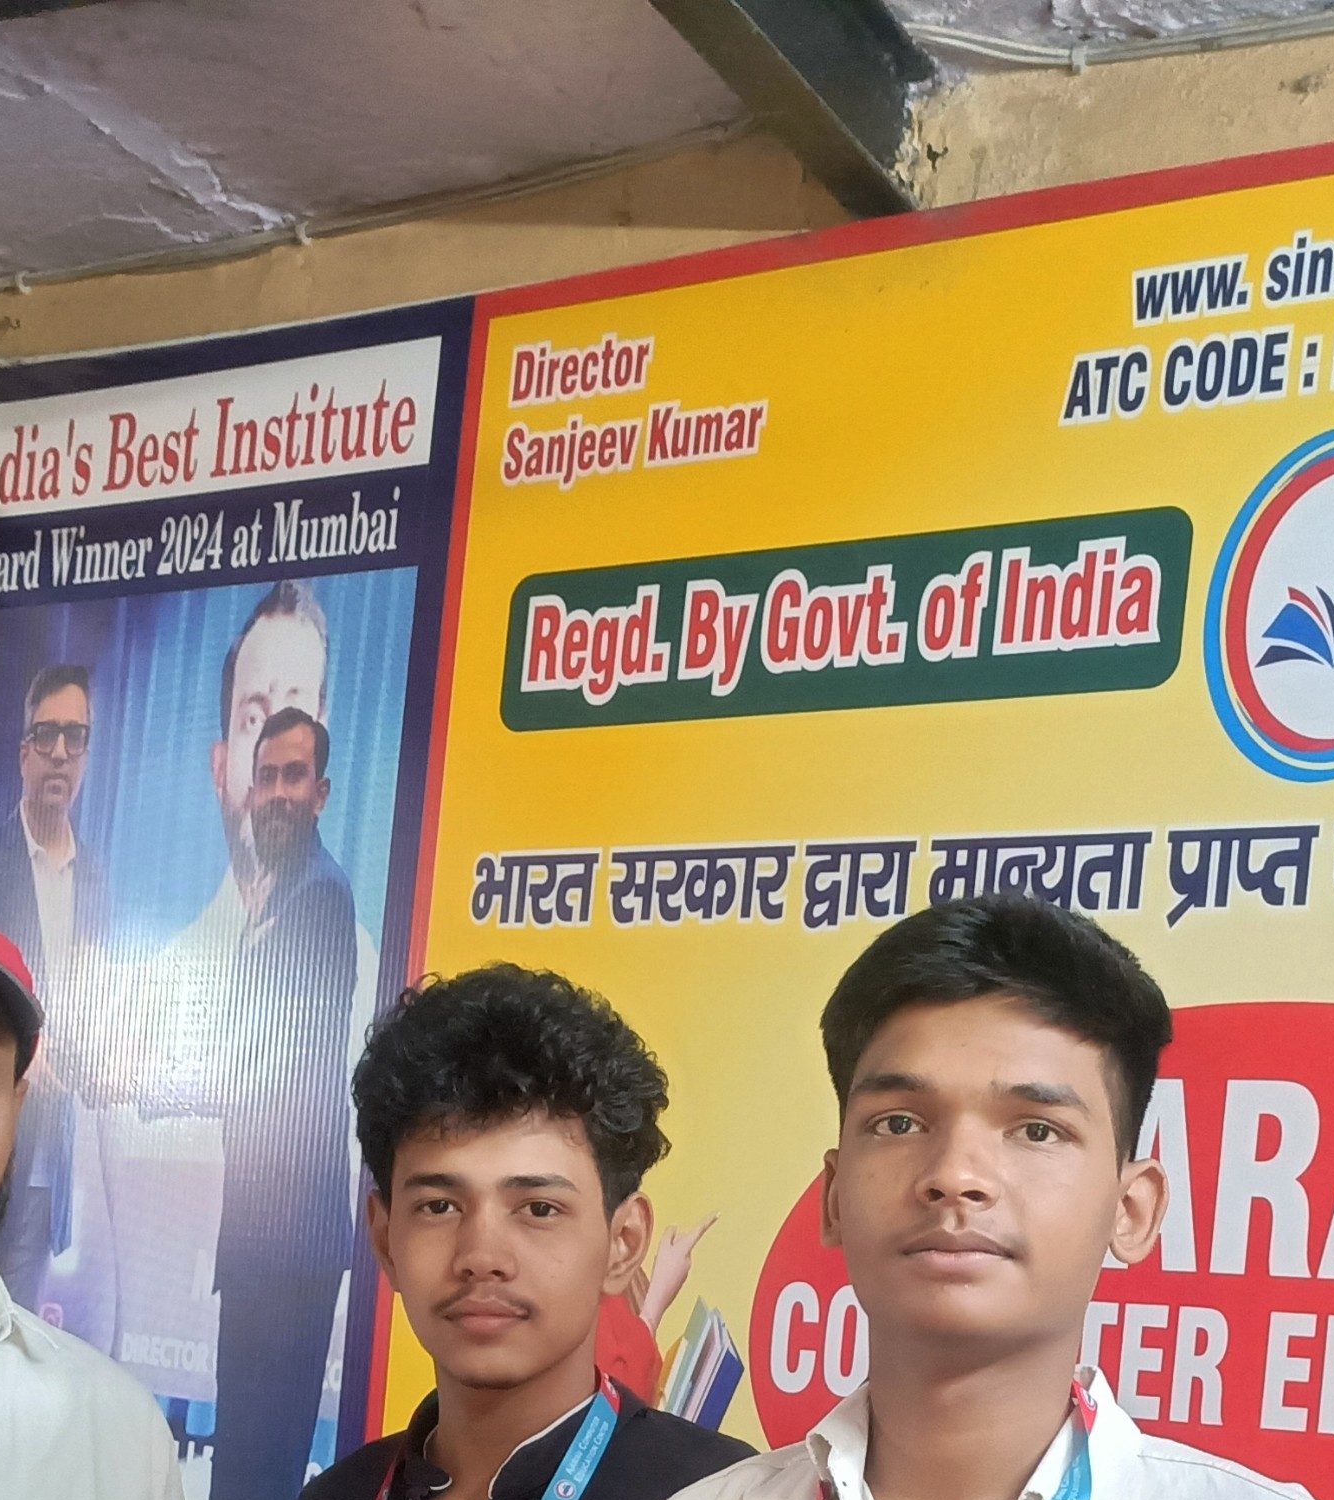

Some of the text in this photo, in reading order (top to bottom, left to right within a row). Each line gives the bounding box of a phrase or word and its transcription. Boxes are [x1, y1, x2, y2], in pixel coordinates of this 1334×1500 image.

[1135, 258, 1248, 321] www.
[512, 338, 650, 402] Director
[1064, 354, 1147, 421] ATC
[1166, 333, 1289, 406] CODE
[1303, 342, 1317, 388] :
[103, 410, 198, 492] Best
[210, 384, 417, 478] Institute
[503, 407, 764, 483] Sanjeev Kumar
[51, 530, 152, 587] Winner
[157, 516, 224, 575] 2024
[231, 523, 263, 567] at
[270, 490, 399, 563] Mumbai
[526, 548, 1153, 698] Regd. By Govt. of India
[472, 851, 598, 925] भारत
[609, 844, 795, 925] सरकार
[803, 841, 916, 928] द्वारा
[929, 832, 1151, 910] मान्यता
[1167, 826, 1320, 928] प्राप्त
[770, 1282, 1228, 1427] COTER
